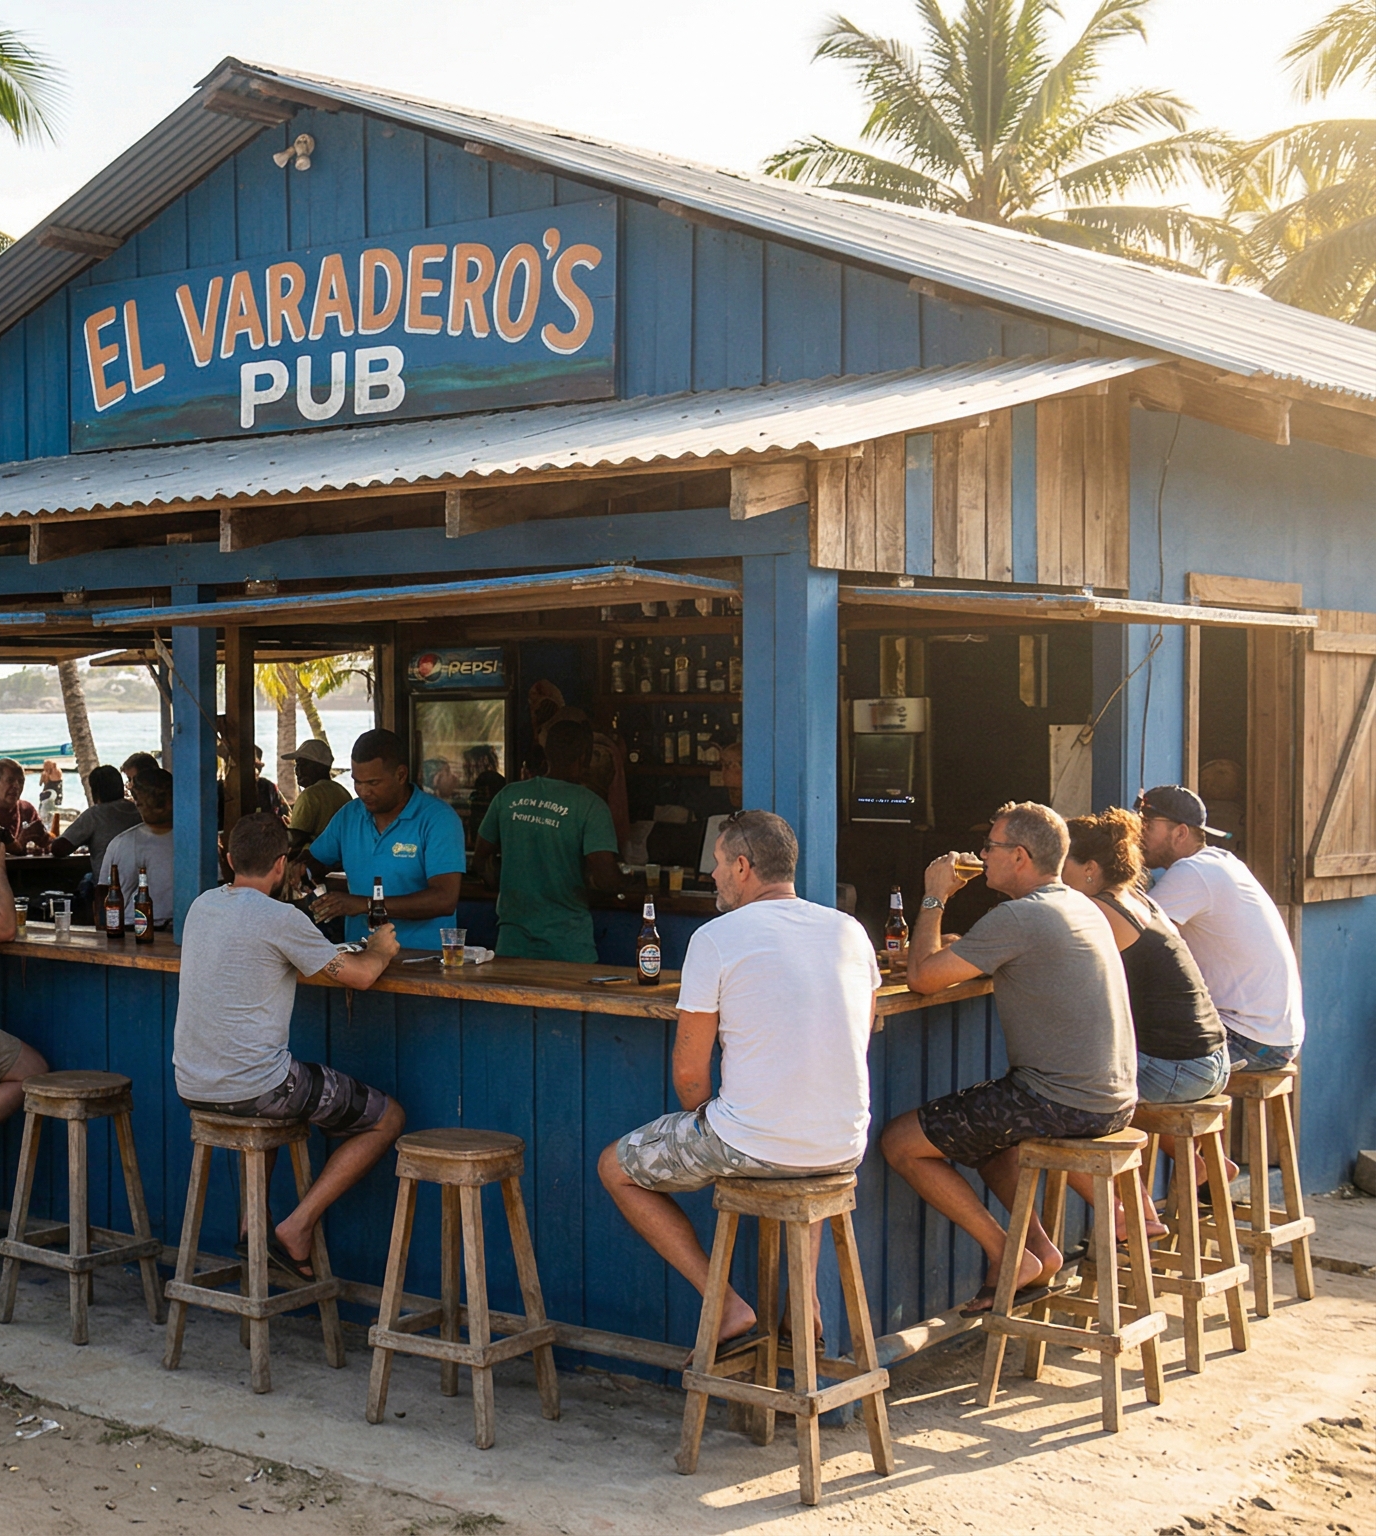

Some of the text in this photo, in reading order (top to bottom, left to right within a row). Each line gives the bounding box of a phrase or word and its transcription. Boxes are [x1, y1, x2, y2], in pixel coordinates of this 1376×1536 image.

[83, 227, 604, 413] EL VARADERO'S
[239, 344, 407, 429] PUB
[448, 660, 498, 678] PEPSI
